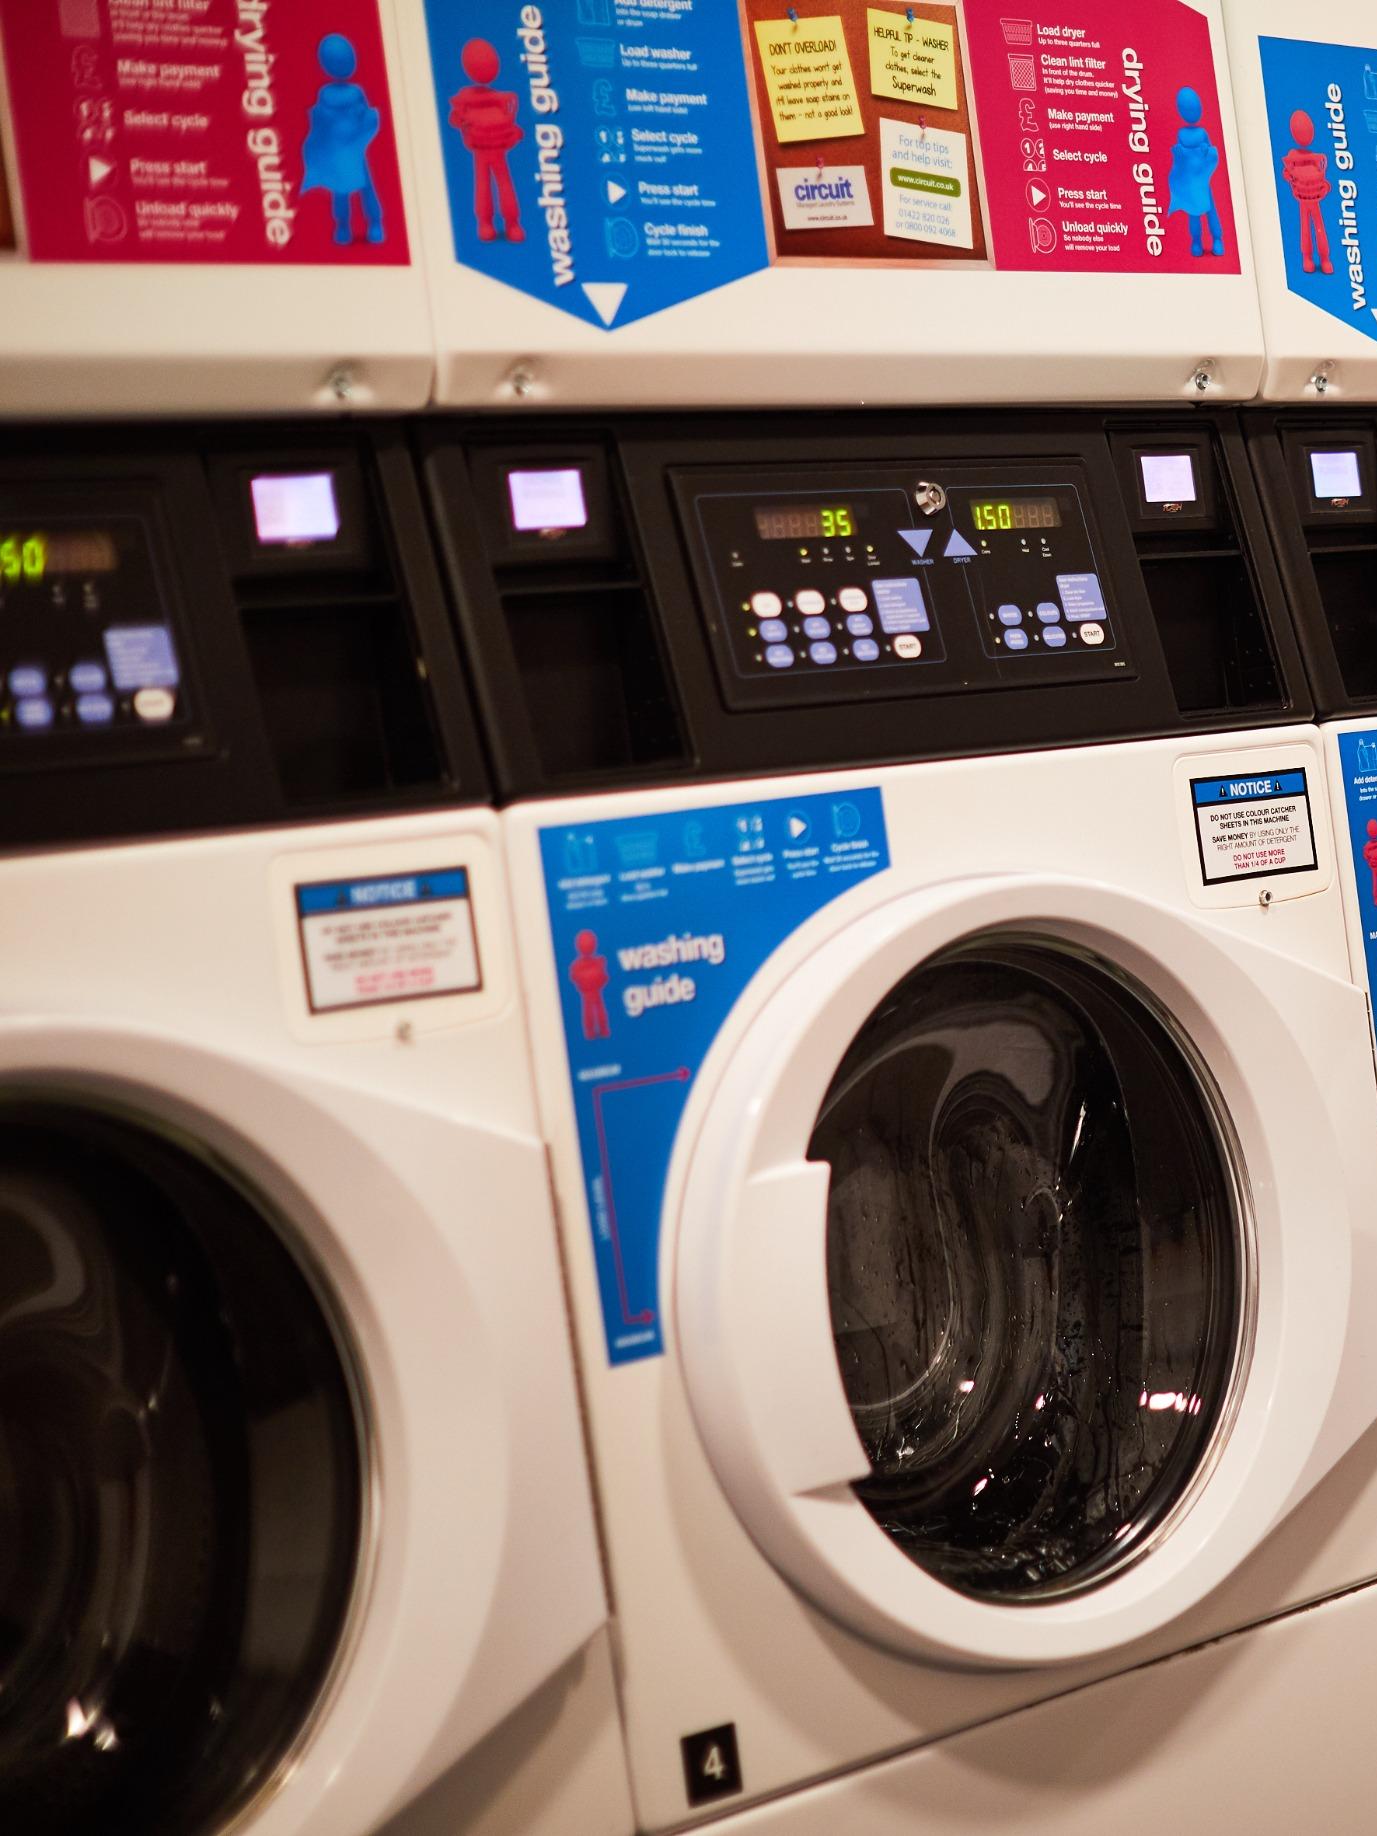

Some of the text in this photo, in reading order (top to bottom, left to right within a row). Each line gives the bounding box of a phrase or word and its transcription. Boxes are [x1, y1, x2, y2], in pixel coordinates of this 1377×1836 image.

[874, 27, 901, 42] HELPFUL
[904, 32, 913, 43] TIP
[922, 37, 949, 51] WASHER
[1037, 24, 1085, 39] Load dryer
[620, 43, 691, 60] Load washer
[769, 40, 837, 56] DON'T OVERLOAD!
[890, 47, 934, 64] To get cleaner
[771, 65, 786, 76] Your
[789, 64, 811, 73] clothes
[832, 61, 842, 73] get
[1041, 54, 1106, 69] Clean lint filter
[831, 77, 842, 86] and
[931, 70, 941, 79] the
[893, 76, 936, 96] Superwash
[626, 88, 708, 106] Make payment
[1048, 108, 1114, 123] Make payment
[631, 128, 698, 146] Select cycle
[899, 134, 949, 156] For top tips
[517, 4, 575, 287] washing guide
[1121, 48, 1165, 256] drying guide
[892, 150, 953, 169] and help visit:
[1053, 149, 1107, 163] Select cycle
[248, 127, 297, 246] guide
[638, 181, 698, 196] Press start
[794, 177, 854, 200] circuit
[897, 174, 953, 191] www.circuit.co.uk
[1058, 187, 1107, 200] Press start
[1324, 83, 1366, 310] washing guide
[644, 222, 708, 237] Cycle finish
[1062, 221, 1128, 235] Unload quickly
[821, 509, 851, 537] 35
[1084, 630, 1100, 638] START
[1230, 780, 1272, 796] NOTICE
[1220, 813, 1232, 821] NOT
[1233, 811, 1244, 819] USE
[1246, 808, 1270, 817] COLOUR
[1271, 806, 1296, 814] CATCHER
[1220, 821, 1242, 829] SHEETS
[1264, 815, 1289, 823] MACHINE
[1212, 835, 1226, 843] SAVE
[1228, 833, 1248, 841] MONEY
[1258, 829, 1274, 837] USING
[1275, 827, 1288, 835] ONLY
[1217, 843, 1234, 851] RIGHT
[1234, 840, 1257, 849] AMOUNT
[1267, 835, 1297, 845] DETERGENT
[618, 933, 726, 972] washing
[622, 975, 696, 1017] guide
[704, 1746, 725, 1780] 4
